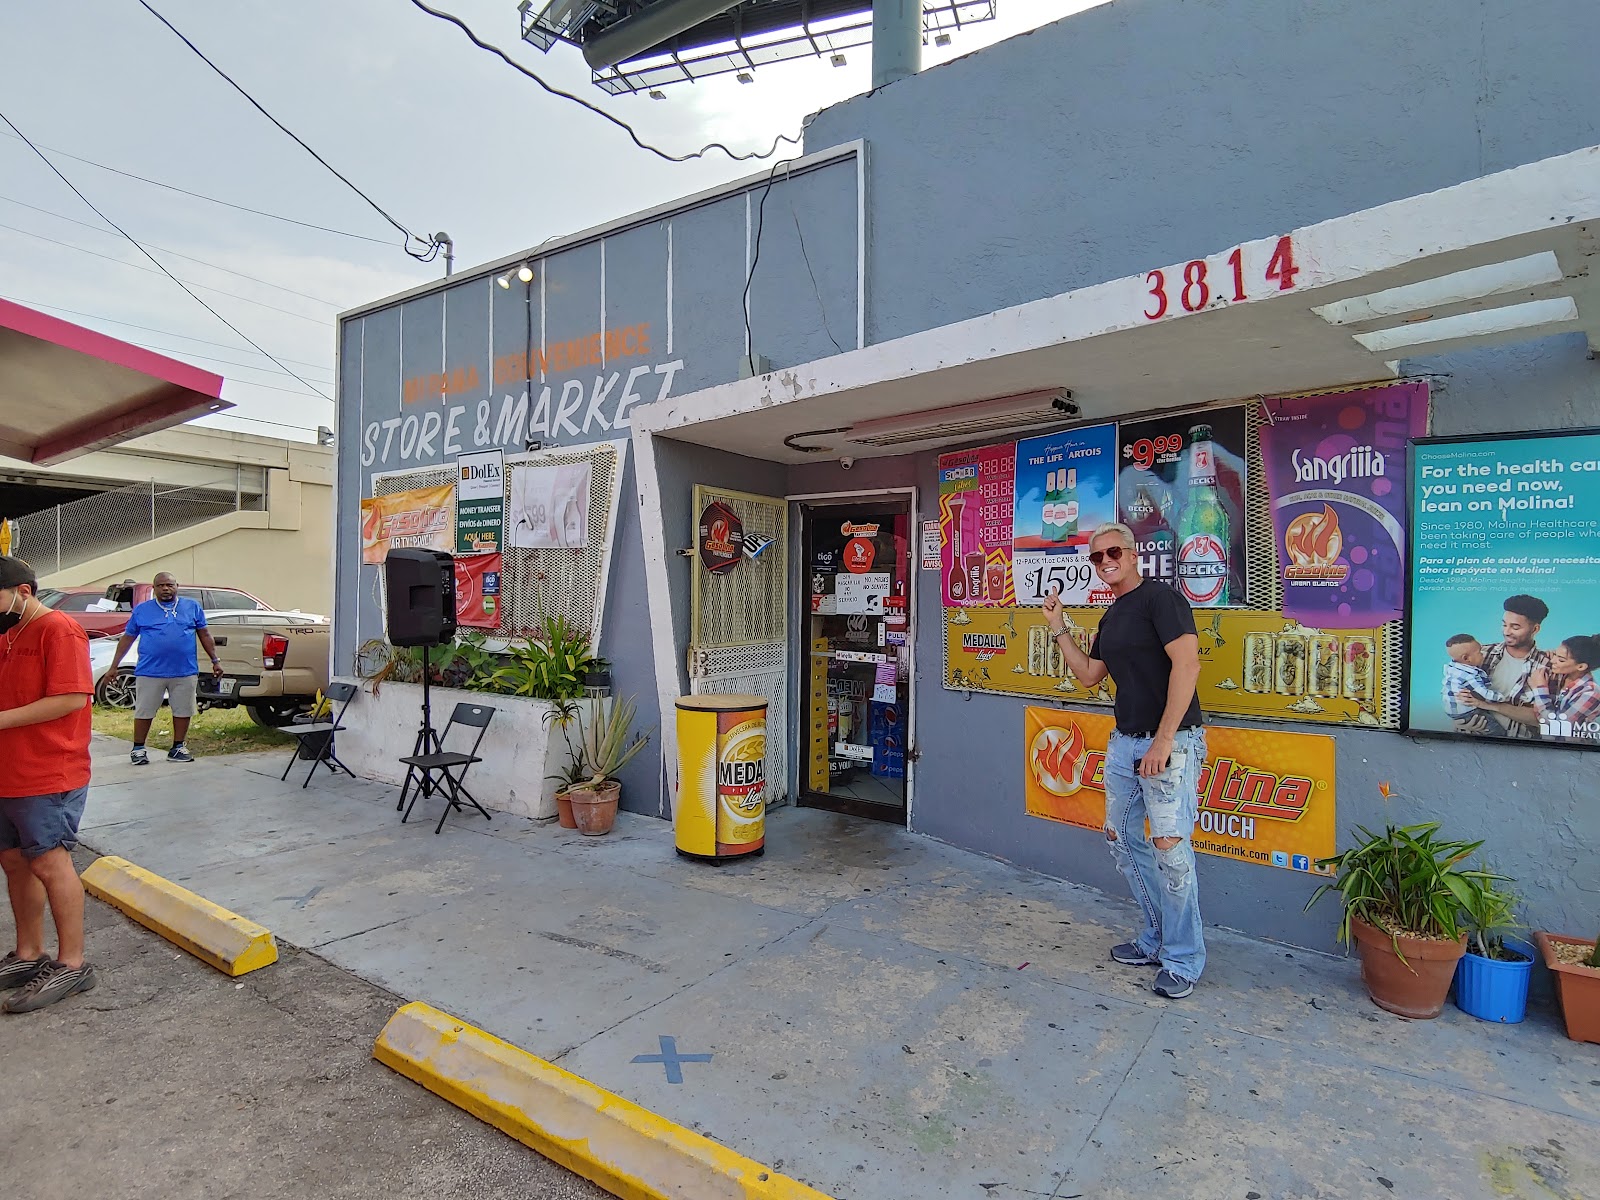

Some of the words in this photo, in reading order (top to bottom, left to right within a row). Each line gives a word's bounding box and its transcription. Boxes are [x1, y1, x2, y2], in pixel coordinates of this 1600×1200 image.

[1144, 235, 1299, 320] 3814
[495, 323, 650, 385] CONVENIENCE
[361, 406, 466, 468] STORE
[473, 400, 491, 446] &
[492, 359, 685, 447] MARKET
[1029, 457, 1044, 465] THE
[1047, 453, 1063, 463] LIFE
[1068, 447, 1101, 460] ARTOIS
[1421, 451, 1496, 460] ChooseMolina.com
[470, 463, 500, 480] DolEx
[1421, 465, 1452, 479] For
[1457, 463, 1491, 477] the
[1496, 459, 1564, 475] health
[1421, 483, 1457, 498] you
[1462, 478, 1511, 494] need
[1517, 479, 1563, 492] now,
[1128, 505, 1154, 513] BECK'S
[1421, 500, 1462, 512] lean
[1467, 500, 1492, 511] on
[1498, 495, 1574, 511] Molina!
[460, 507, 477, 515] MONEY
[477, 505, 501, 513] TRANSFER
[483, 518, 501, 527] DINERO
[1420, 522, 1451, 531] Since
[1454, 521, 1485, 531] 1980,
[1488, 520, 1527, 530] Molina
[1530, 519, 1597, 529] Healthcare
[481, 532, 496, 540] HERE
[1420, 531, 1448, 540] been
[1450, 530, 1486, 541] taking
[1489, 531, 1515, 539] care
[1519, 530, 1531, 538] of
[1534, 530, 1575, 540] people
[1420, 540, 1447, 549] need
[1451, 540, 1458, 549] it
[1461, 541, 1493, 549] most.
[1016, 557, 1040, 565] 12-PACK
[1419, 557, 1444, 565] Para
[1446, 556, 1455, 564] el
[1456, 557, 1480, 566] plan
[1482, 556, 1496, 564] de
[1497, 556, 1527, 564] salud
[1530, 558, 1550, 566] que
[1179, 562, 1226, 575] BECK'S
[1284, 564, 1348, 580] Gasolina
[1419, 566, 1449, 574] ahora
[1451, 566, 1497, 576] ¡apóyate
[1515, 566, 1556, 574] Molina!
[1469, 576, 1497, 584] Molina
[1418, 585, 1455, 593] personas
[883, 607, 906, 615] PULL
[962, 633, 1007, 648] MEDALLA
[1080, 751, 1314, 823] GLina
